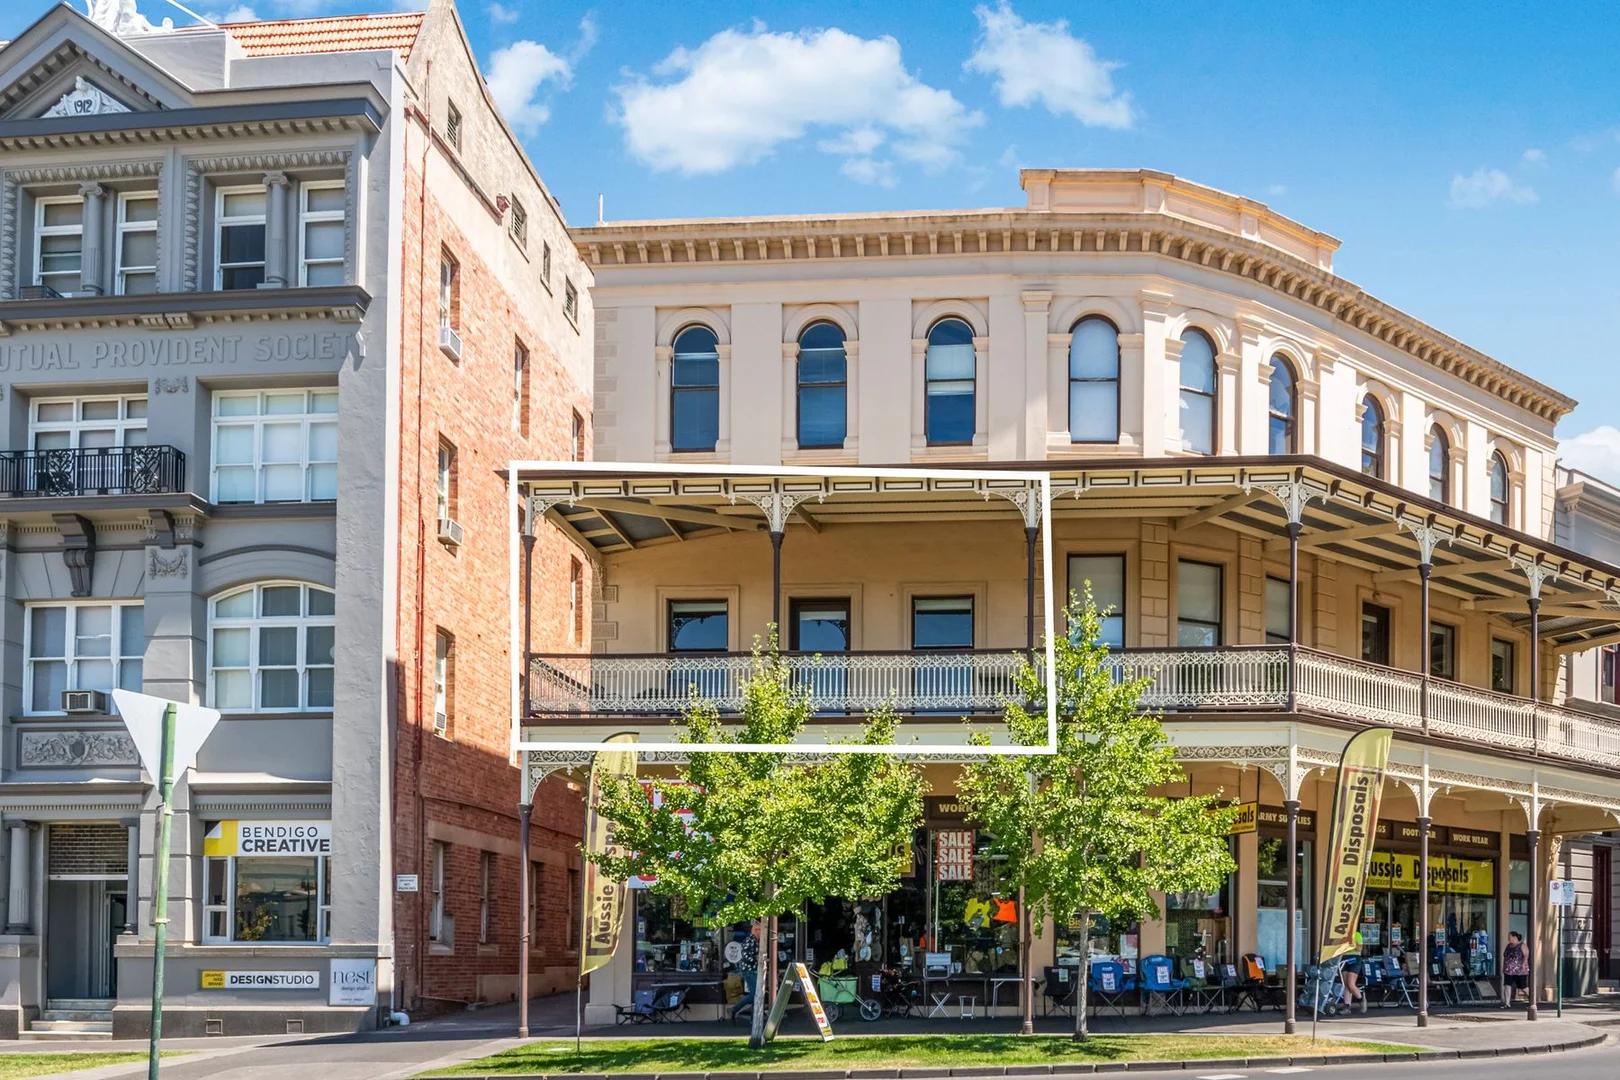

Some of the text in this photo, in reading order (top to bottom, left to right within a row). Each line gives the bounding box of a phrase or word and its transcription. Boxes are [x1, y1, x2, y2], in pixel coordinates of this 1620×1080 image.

[74, 99, 93, 114] 1912
[91, 336, 243, 368] PROVIDENT
[939, 803, 974, 813] WORK
[1342, 776, 1369, 866] Disposals
[242, 826, 318, 838] BENDIGO
[939, 831, 972, 847] SALE
[1452, 833, 1489, 845] WORK WEAR
[241, 838, 330, 853] CREATIVE
[939, 848, 972, 864] SALE
[939, 864, 972, 880] SALE
[1413, 859, 1469, 886] Dsposals
[1334, 876, 1356, 935] Aussie
[594, 885, 615, 945] Aussie
[230, 975, 315, 985] DESIGNSTUDIO
